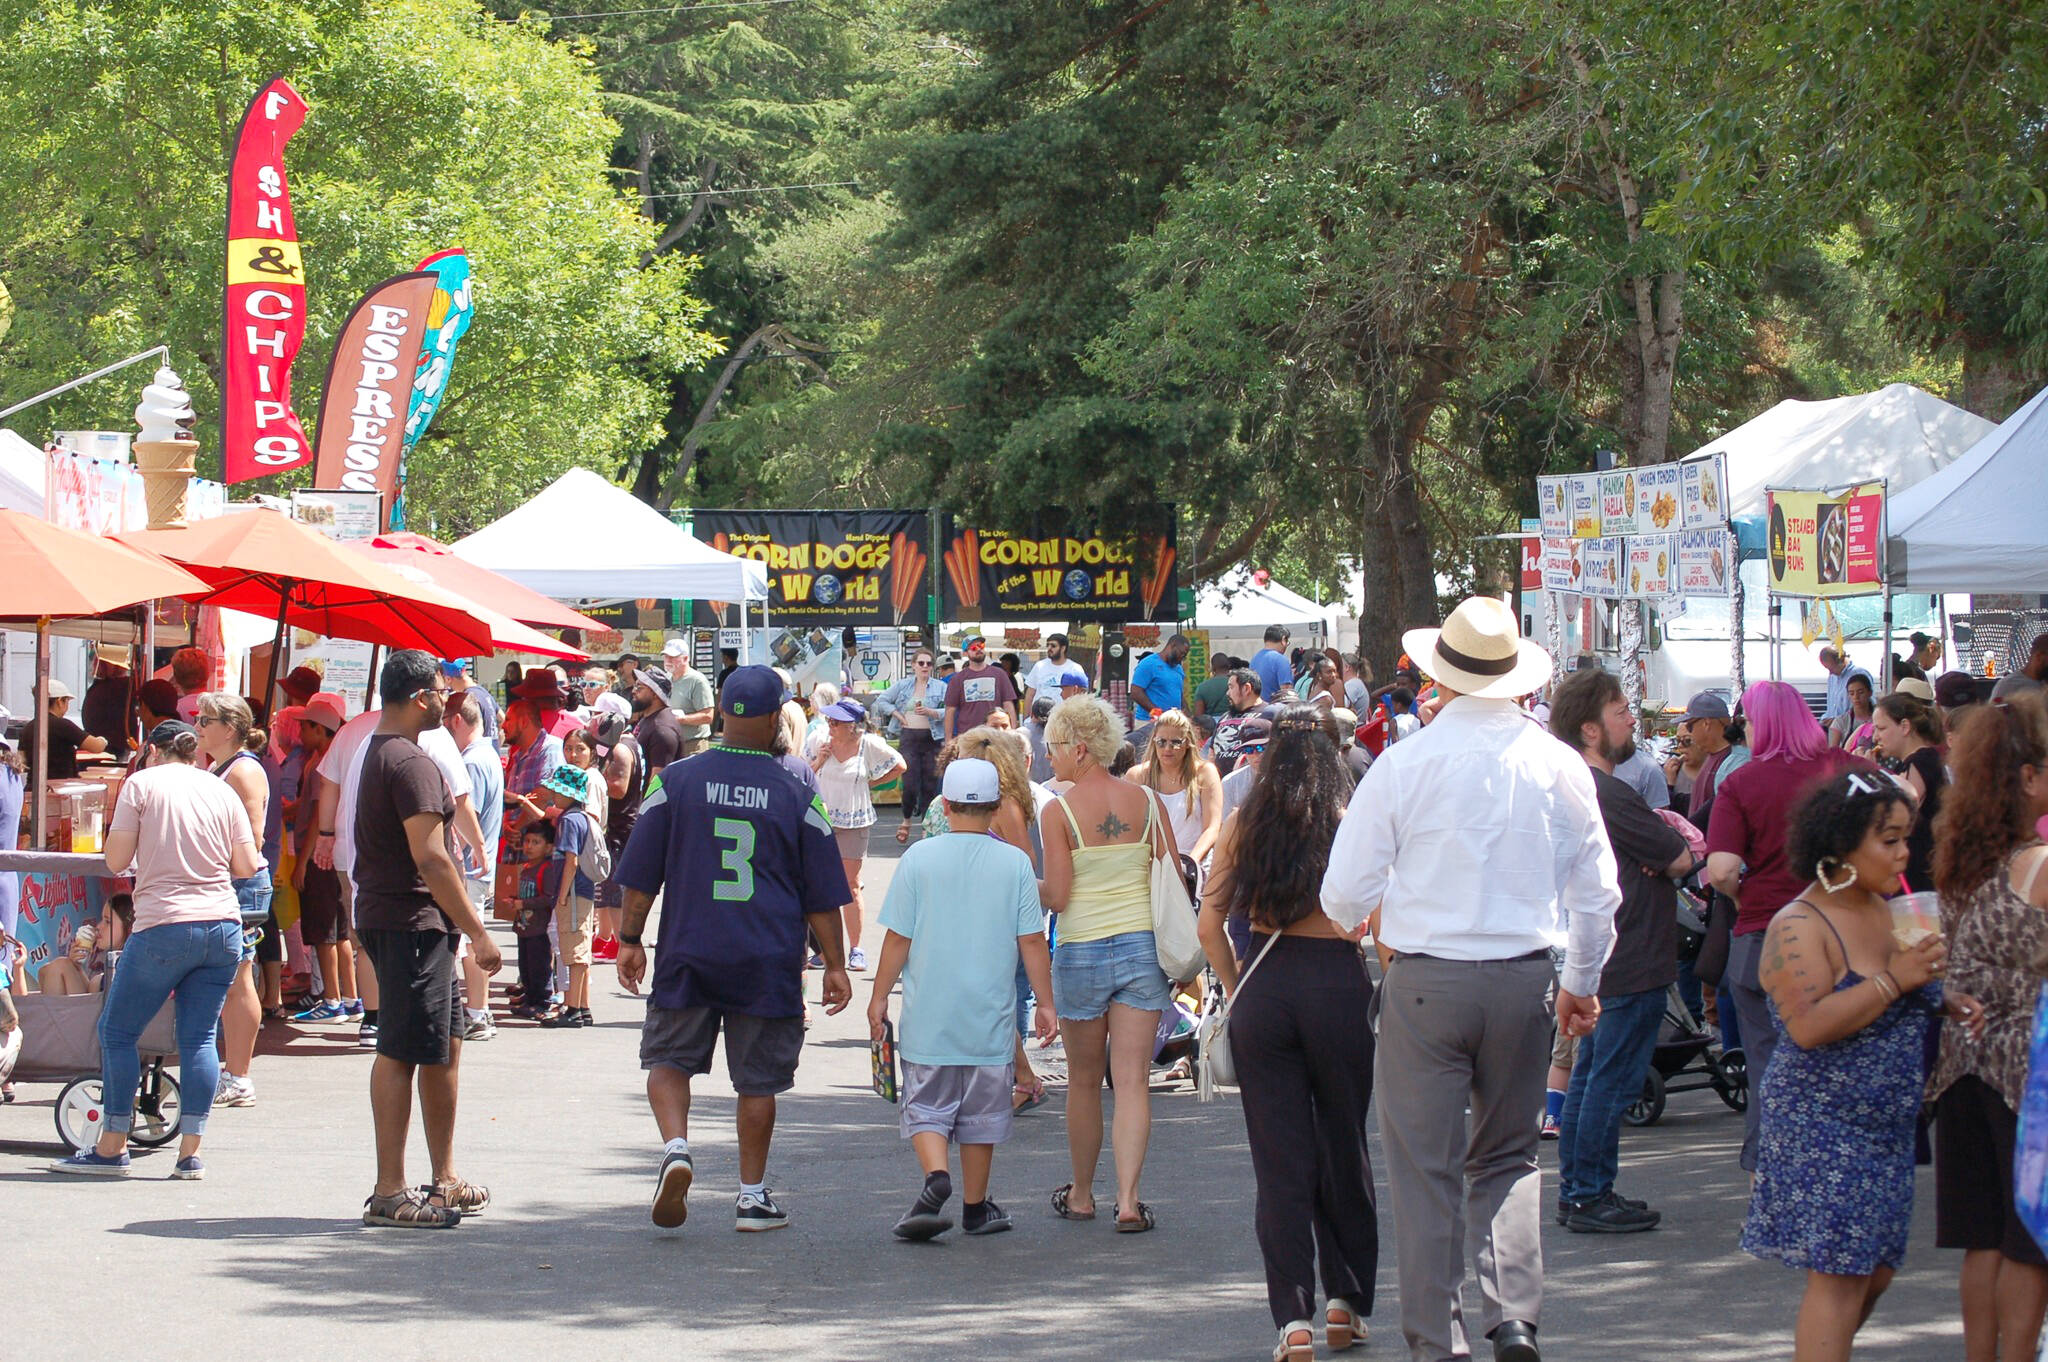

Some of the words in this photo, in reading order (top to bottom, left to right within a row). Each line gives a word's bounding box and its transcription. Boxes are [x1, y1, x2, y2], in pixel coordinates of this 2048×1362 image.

[248, 246, 298, 278] &
[245, 289, 301, 465] CHIPS
[340, 303, 409, 490] ESPRESS
[1638, 471, 1656, 486] CHICKEN
[1657, 468, 1678, 485] TENDERS
[1684, 465, 1698, 480] GREEK
[1686, 485, 1700, 502] FRIES
[1787, 518, 1816, 535] STEAMED
[729, 533, 741, 542] The
[743, 533, 770, 543] Original
[845, 533, 863, 542] Hand
[865, 533, 889, 543] Dipped
[1680, 530, 1706, 549] SALMON
[815, 542, 891, 570] DOGS
[980, 538, 1059, 565] CORN
[1065, 538, 1134, 565] DOG
[1787, 555, 1804, 571] BUNS
[997, 582, 1010, 594] of
[1010, 574, 1028, 588] the
[706, 781, 769, 810] WILSON
[712, 817, 756, 901] 3
